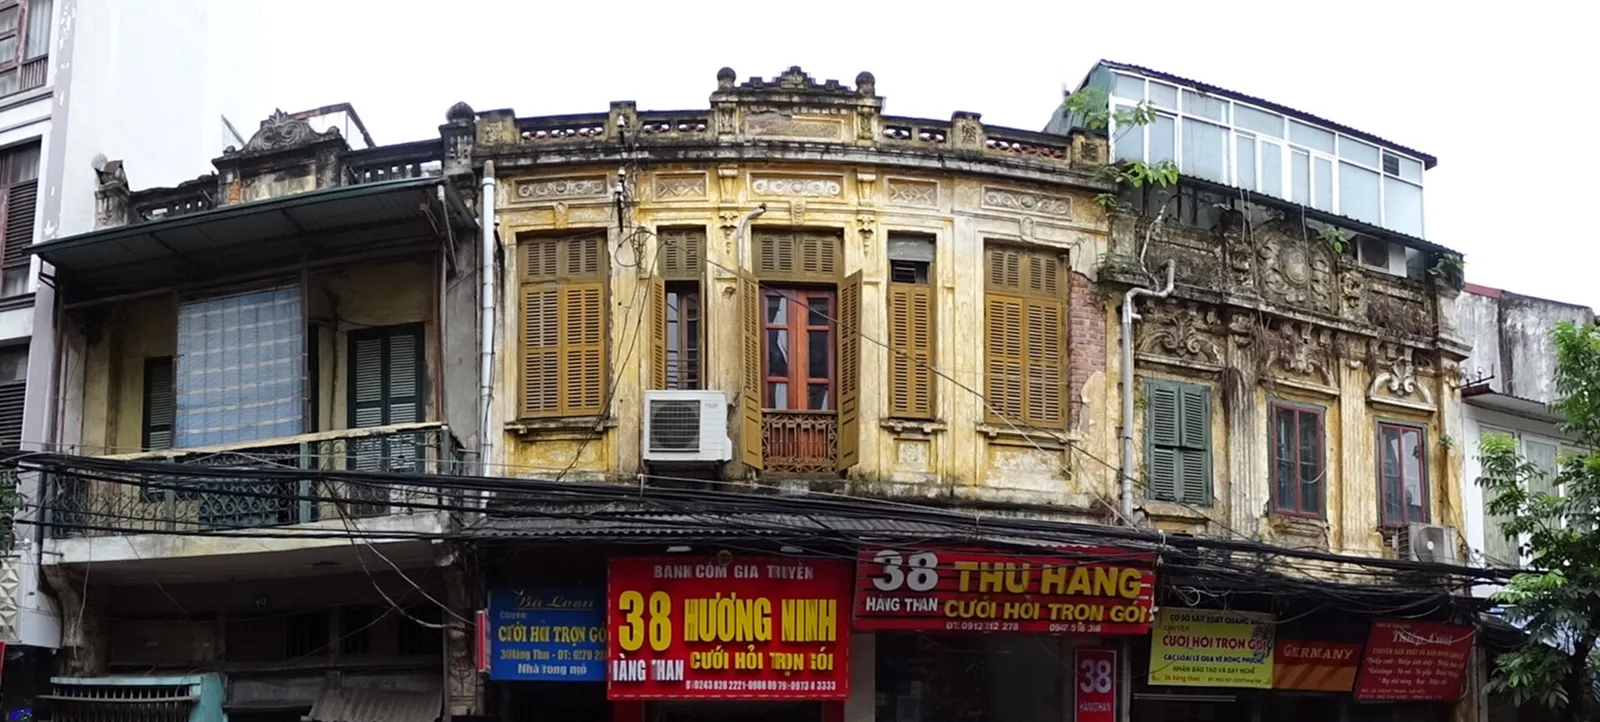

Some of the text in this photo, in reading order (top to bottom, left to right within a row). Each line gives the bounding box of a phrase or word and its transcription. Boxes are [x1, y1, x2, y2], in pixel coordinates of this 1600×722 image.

[734, 564, 759, 579] GIA
[872, 550, 938, 591] 38
[619, 591, 672, 651] 38
[781, 599, 837, 642] NINH
[690, 645, 729, 670] CƯỚI
[735, 644, 763, 670] HỎI
[1283, 643, 1354, 660] GERMANY
[1080, 659, 1112, 693] 38
